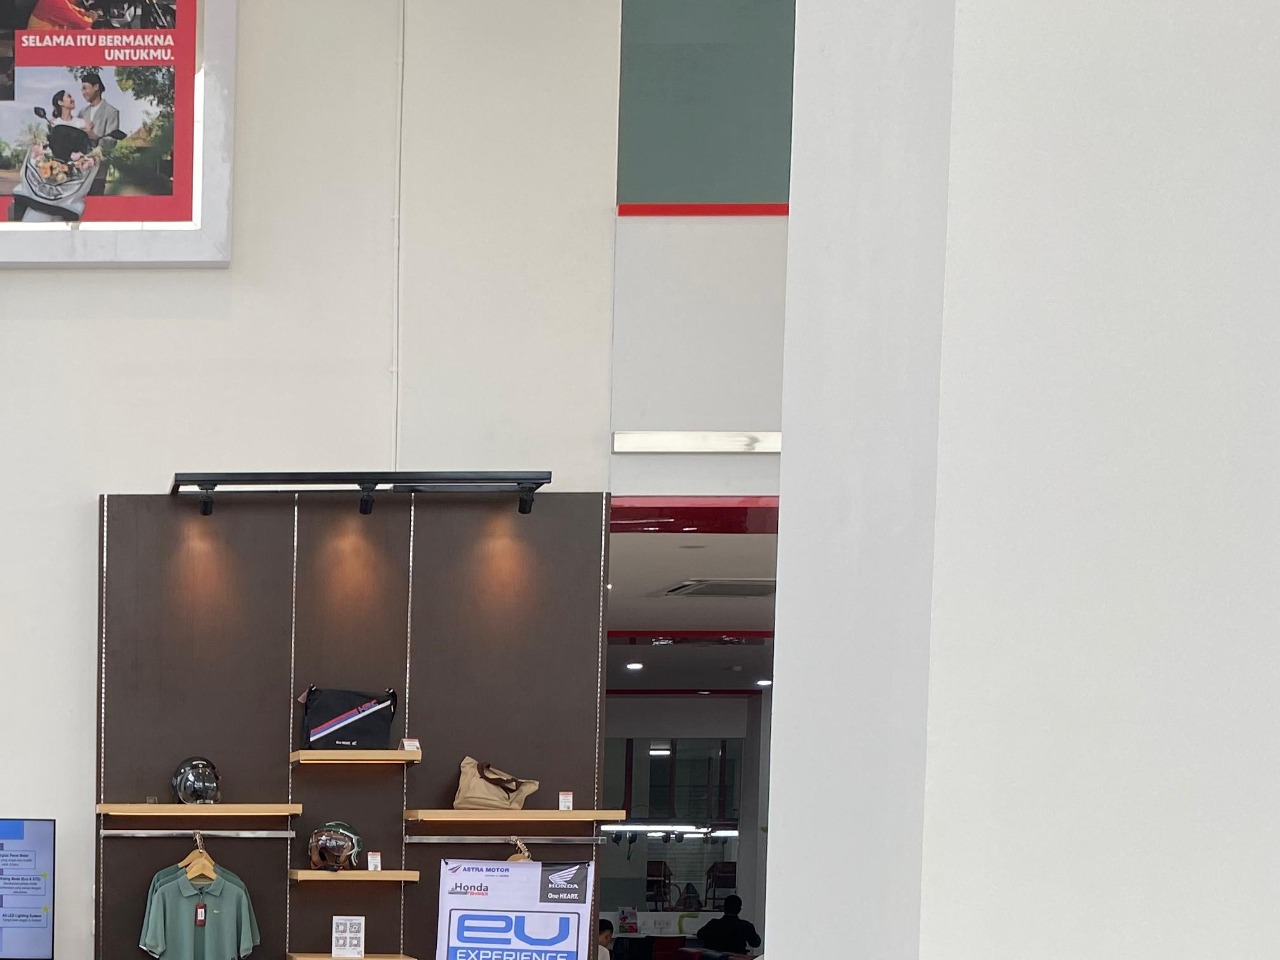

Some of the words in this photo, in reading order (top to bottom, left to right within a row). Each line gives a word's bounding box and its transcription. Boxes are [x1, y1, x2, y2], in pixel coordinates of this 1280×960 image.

[21, 35, 73, 47] SELAMA
[77, 35, 96, 47] ITU
[98, 35, 174, 47] BERMAKNA
[104, 49, 175, 61] UNTUKMU.
[455, 883, 489, 891] Honda
